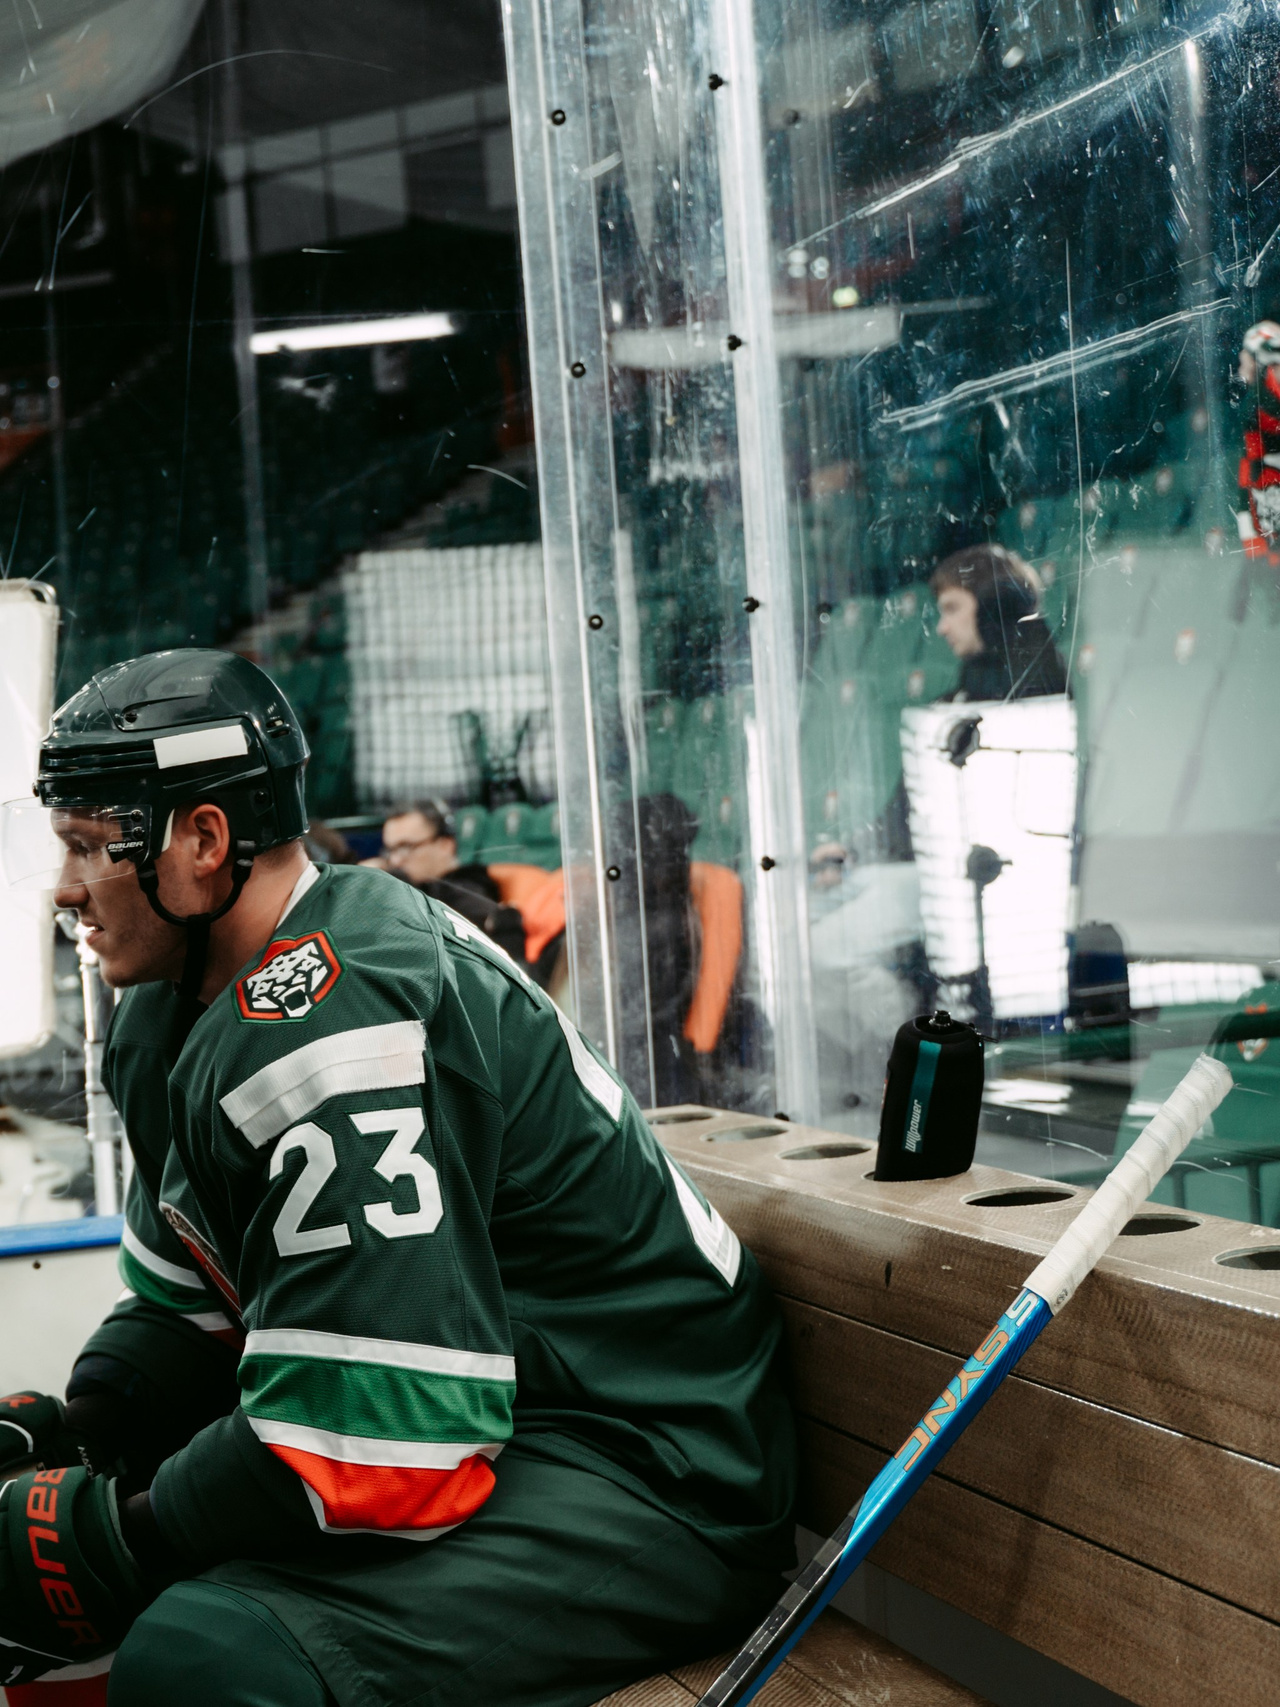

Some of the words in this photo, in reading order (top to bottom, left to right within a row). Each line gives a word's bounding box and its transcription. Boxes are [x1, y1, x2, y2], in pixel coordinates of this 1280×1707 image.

[107, 840, 144, 850] BAUER
[269, 1107, 444, 1257] 23
[905, 1099, 922, 1153] Willpower
[894, 1324, 1010, 1472] SYNC
[26, 1467, 102, 1646] BAUER
